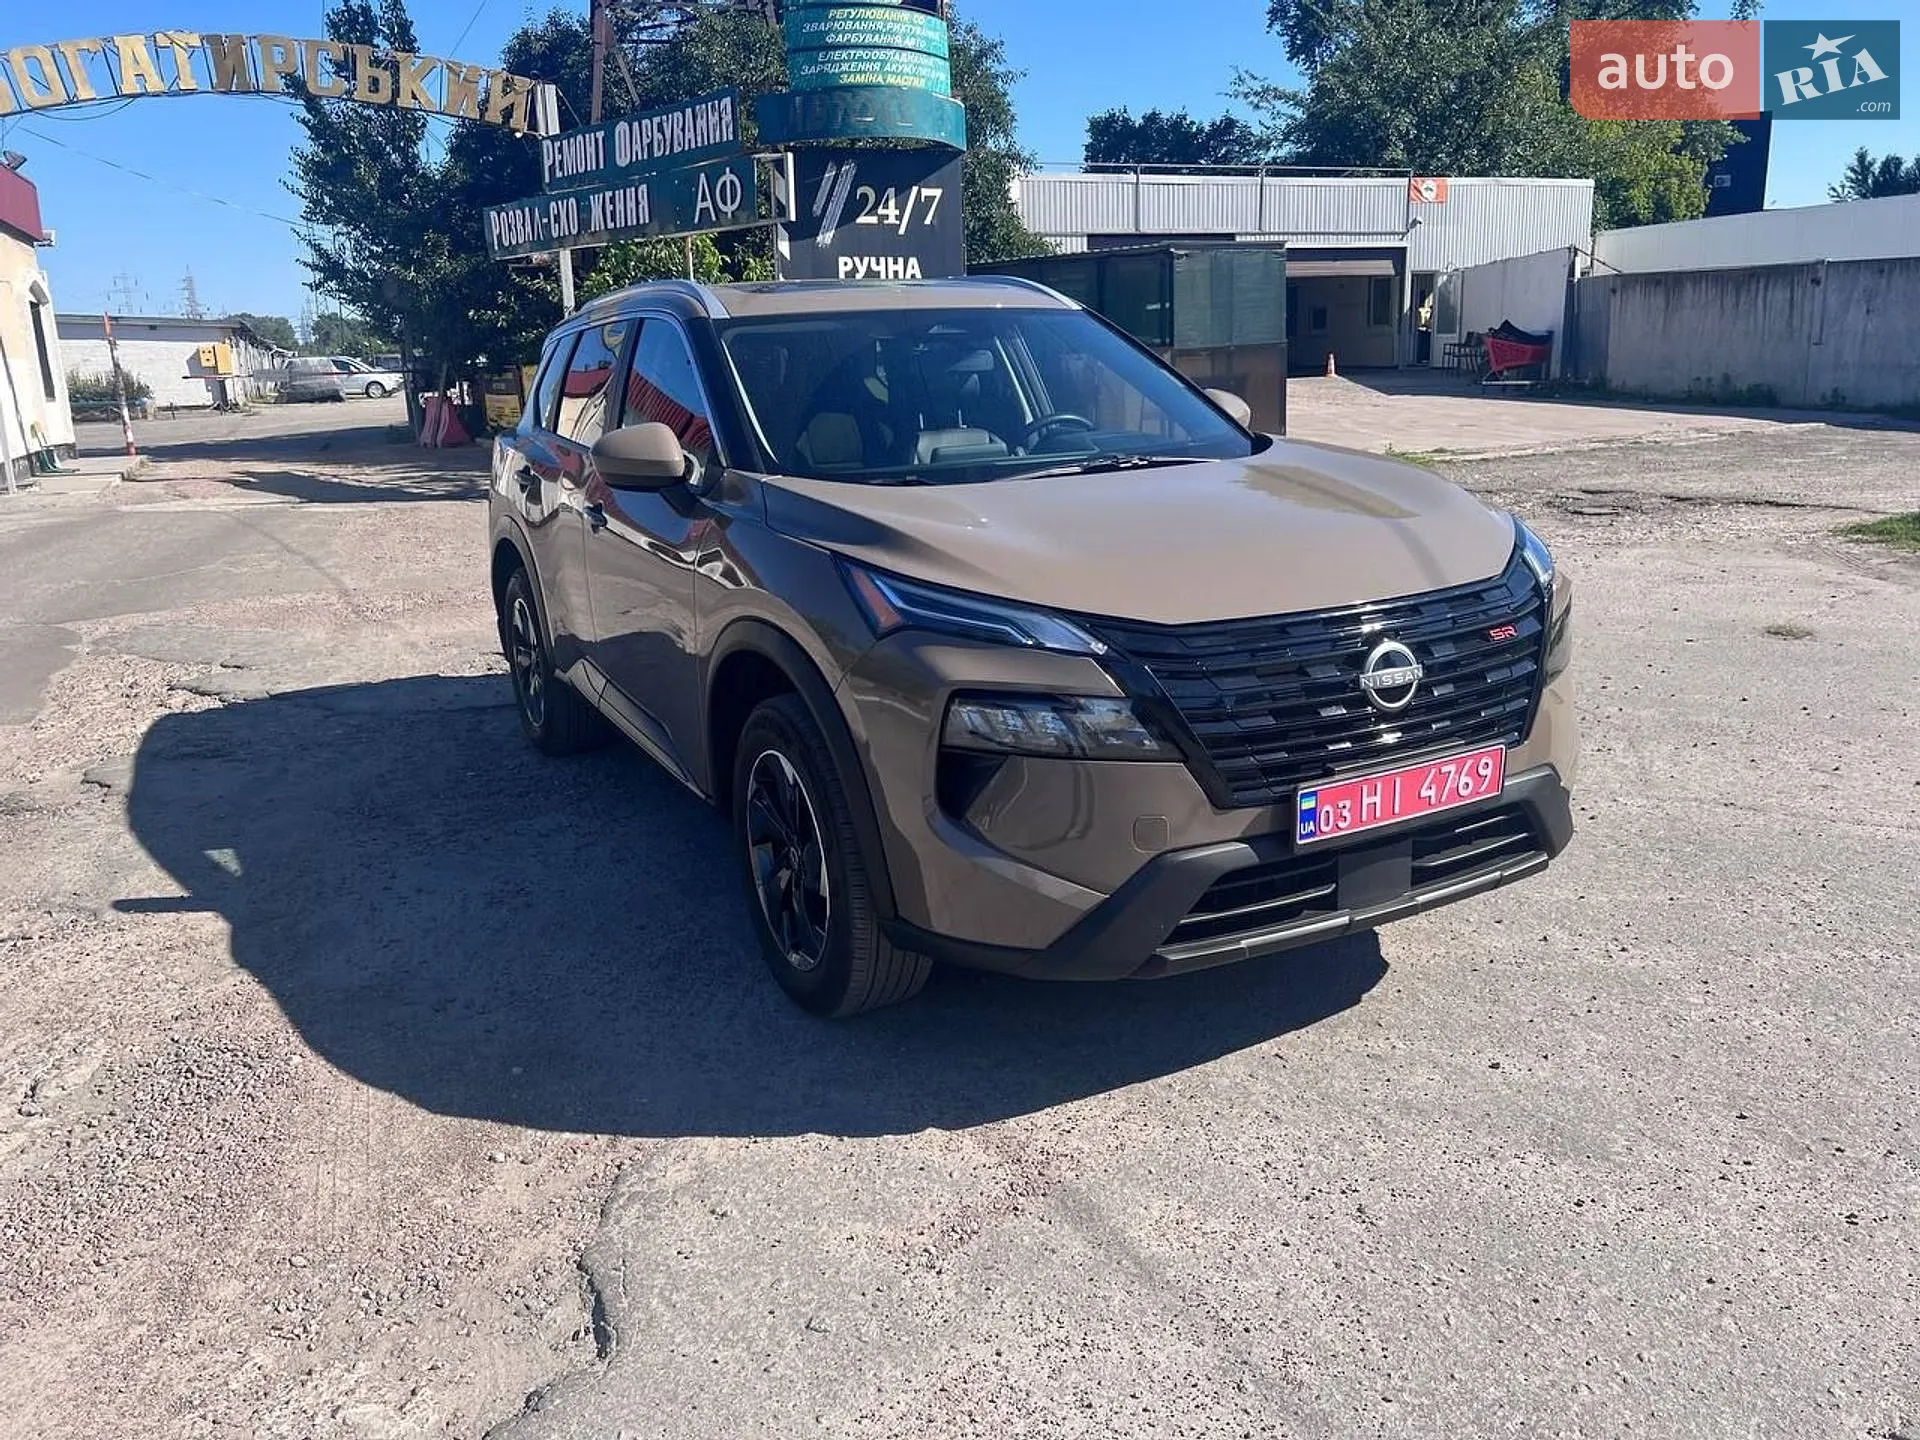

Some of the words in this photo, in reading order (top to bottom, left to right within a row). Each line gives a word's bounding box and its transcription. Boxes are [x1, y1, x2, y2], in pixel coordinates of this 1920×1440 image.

[825, 32, 902, 45] ФАРБУВАННЯ
[886, 22, 939, 41] РИХТУВА
[800, 61, 880, 75] ЗАРЯДЖЕННЯ
[818, 50, 937, 67] ЕЛЕКТРООБЛАДН
[0, 32, 534, 130] ОГАТИРСЬКИЙ
[541, 131, 606, 184] РЕМОНТ
[614, 96, 734, 168] ФАРБУВАННЯ
[693, 167, 742, 224] АФ
[855, 184, 944, 236] 24/7
[838, 256, 922, 280] РУЧНА
[1489, 626, 1518, 642] SR
[1361, 668, 1422, 689] NISSAN
[1319, 798, 1352, 833] 03
[1419, 756, 1494, 806] 4769
[1300, 821, 1315, 835] UA
